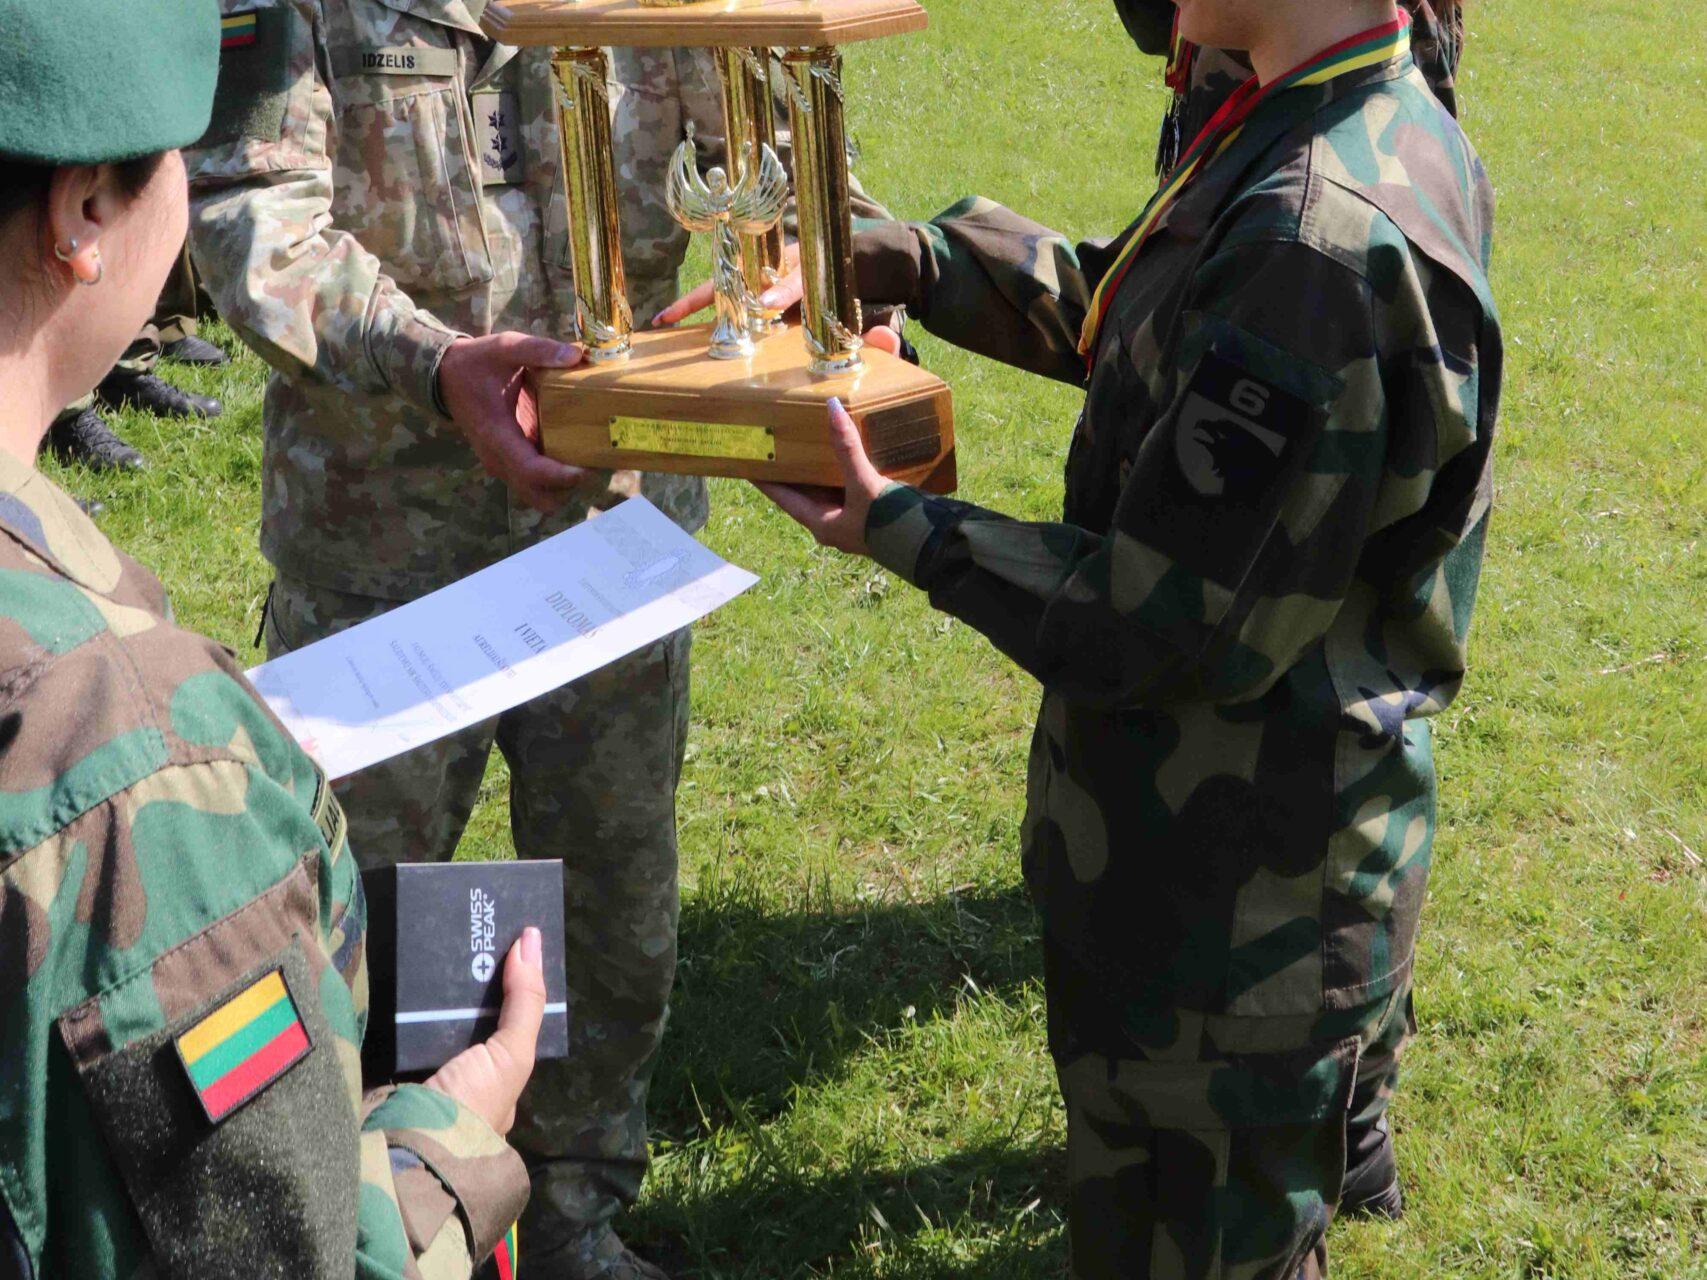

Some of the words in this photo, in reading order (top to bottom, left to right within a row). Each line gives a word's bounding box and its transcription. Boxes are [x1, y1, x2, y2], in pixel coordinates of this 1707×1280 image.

[362, 53, 415, 69] IDZELIS
[1229, 378, 1270, 417] 6
[544, 590, 602, 641] DIPLOMAS
[470, 888, 483, 952] SWISS
